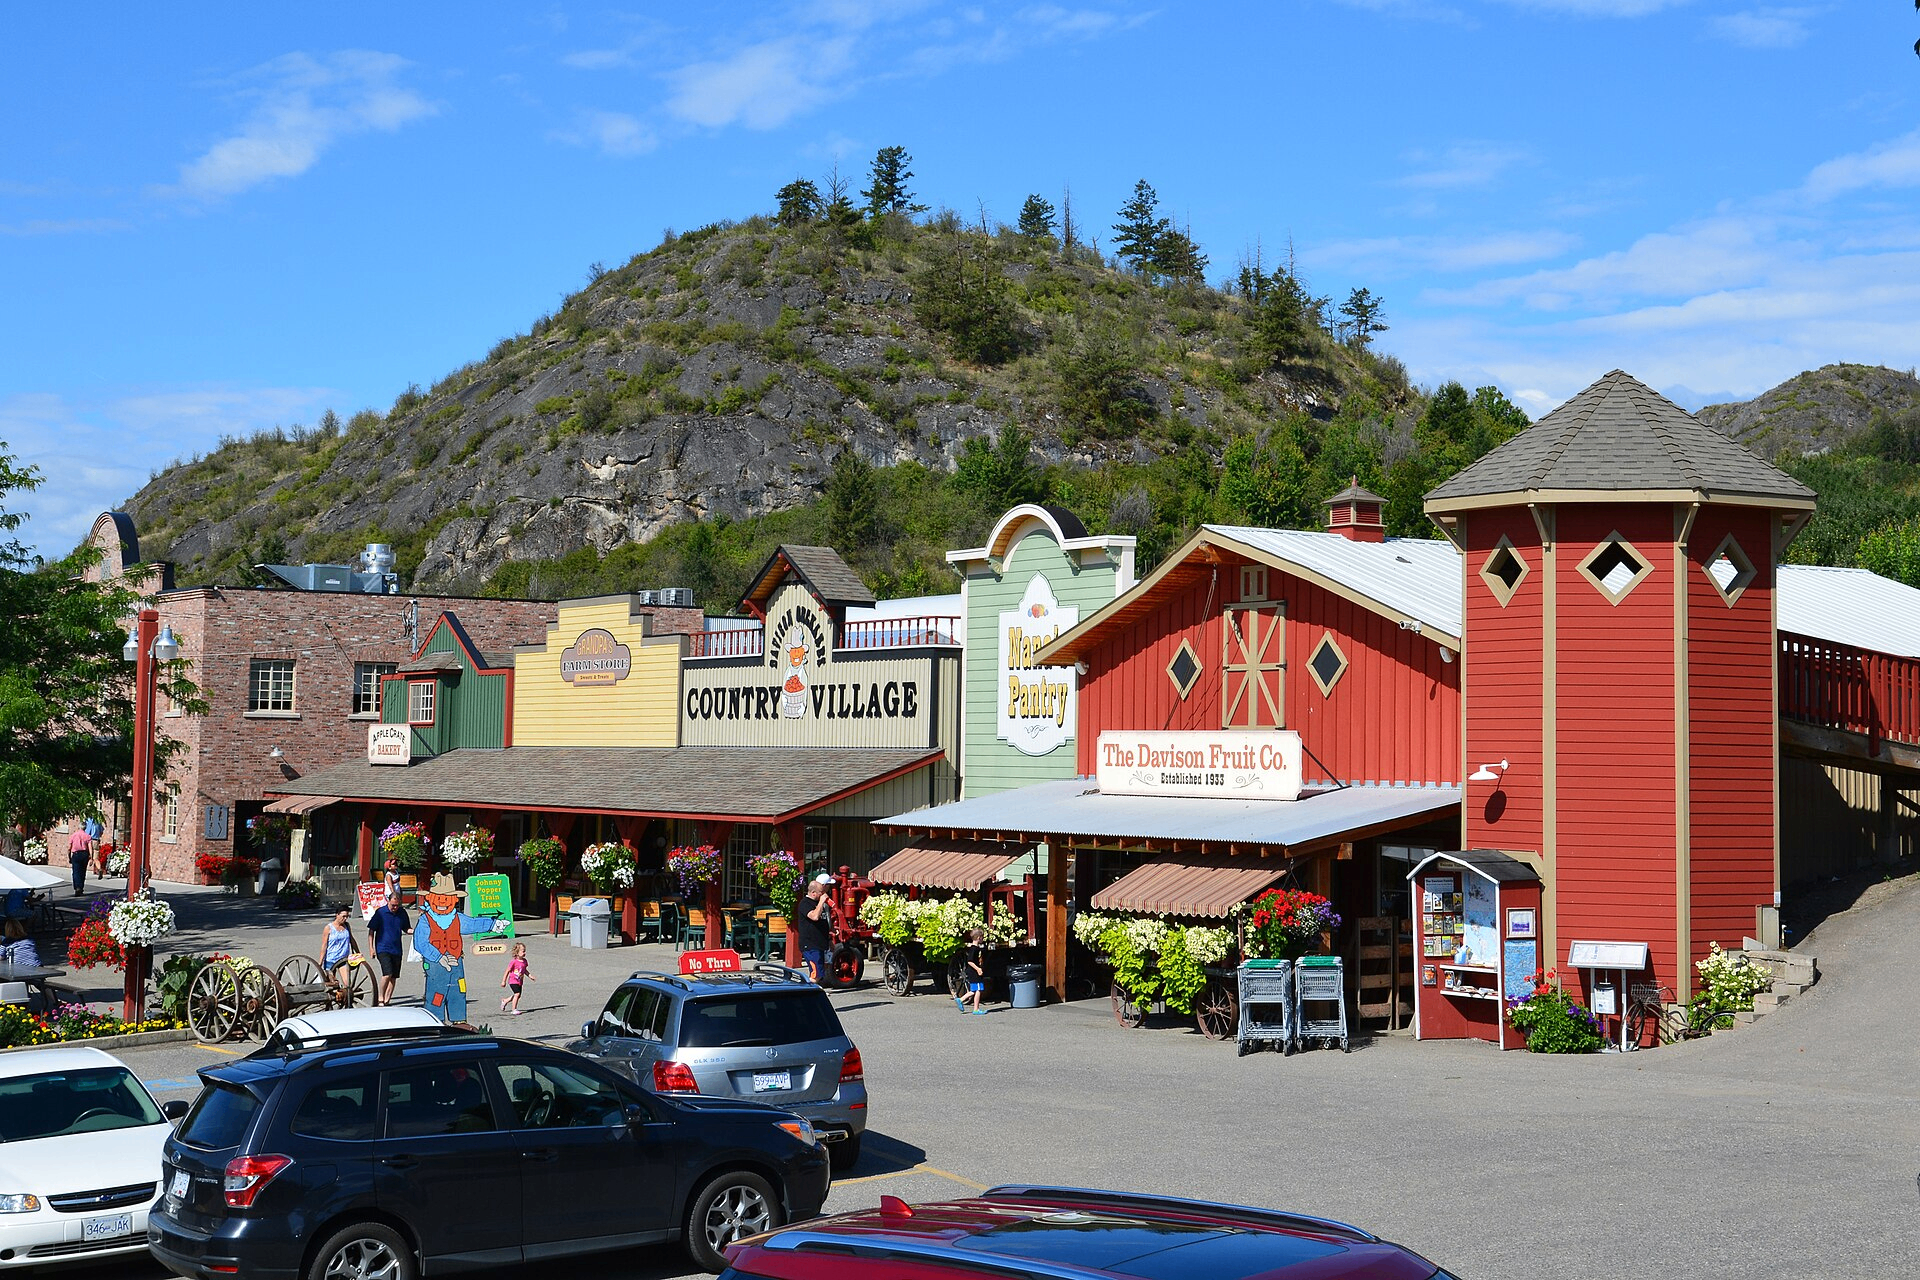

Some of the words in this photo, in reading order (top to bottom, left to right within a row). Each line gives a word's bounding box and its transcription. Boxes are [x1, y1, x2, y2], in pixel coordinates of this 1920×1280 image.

[577, 634, 613, 656] GRANDPA'S
[769, 608, 794, 669] DAVISON
[563, 660, 591, 672] FARM
[593, 658, 629, 670] STORE
[686, 686, 783, 720] COUNTRY
[811, 681, 918, 719] VILLAGE
[1008, 675, 1068, 728] Pantry
[373, 730, 388, 744] APPLE
[390, 728, 405, 744] CRATE
[378, 745, 401, 755] BAKERY
[1104, 743, 1134, 767] The
[1138, 743, 1205, 769] Davison
[1209, 744, 1256, 770] Fruit
[1260, 744, 1287, 770] Co.
[1161, 772, 1202, 785] Established
[1205, 773, 1225, 786] 1933
[475, 879, 502, 887] Johnny
[478, 887, 502, 895] Popper
[481, 901, 501, 909] Rides
[689, 958, 702, 970] No
[706, 957, 731, 969] Thru
[755, 1075, 770, 1087] 599
[774, 1074, 789, 1085] AVP
[86, 1222, 106, 1236] 346
[111, 1219, 129, 1233] JAK
